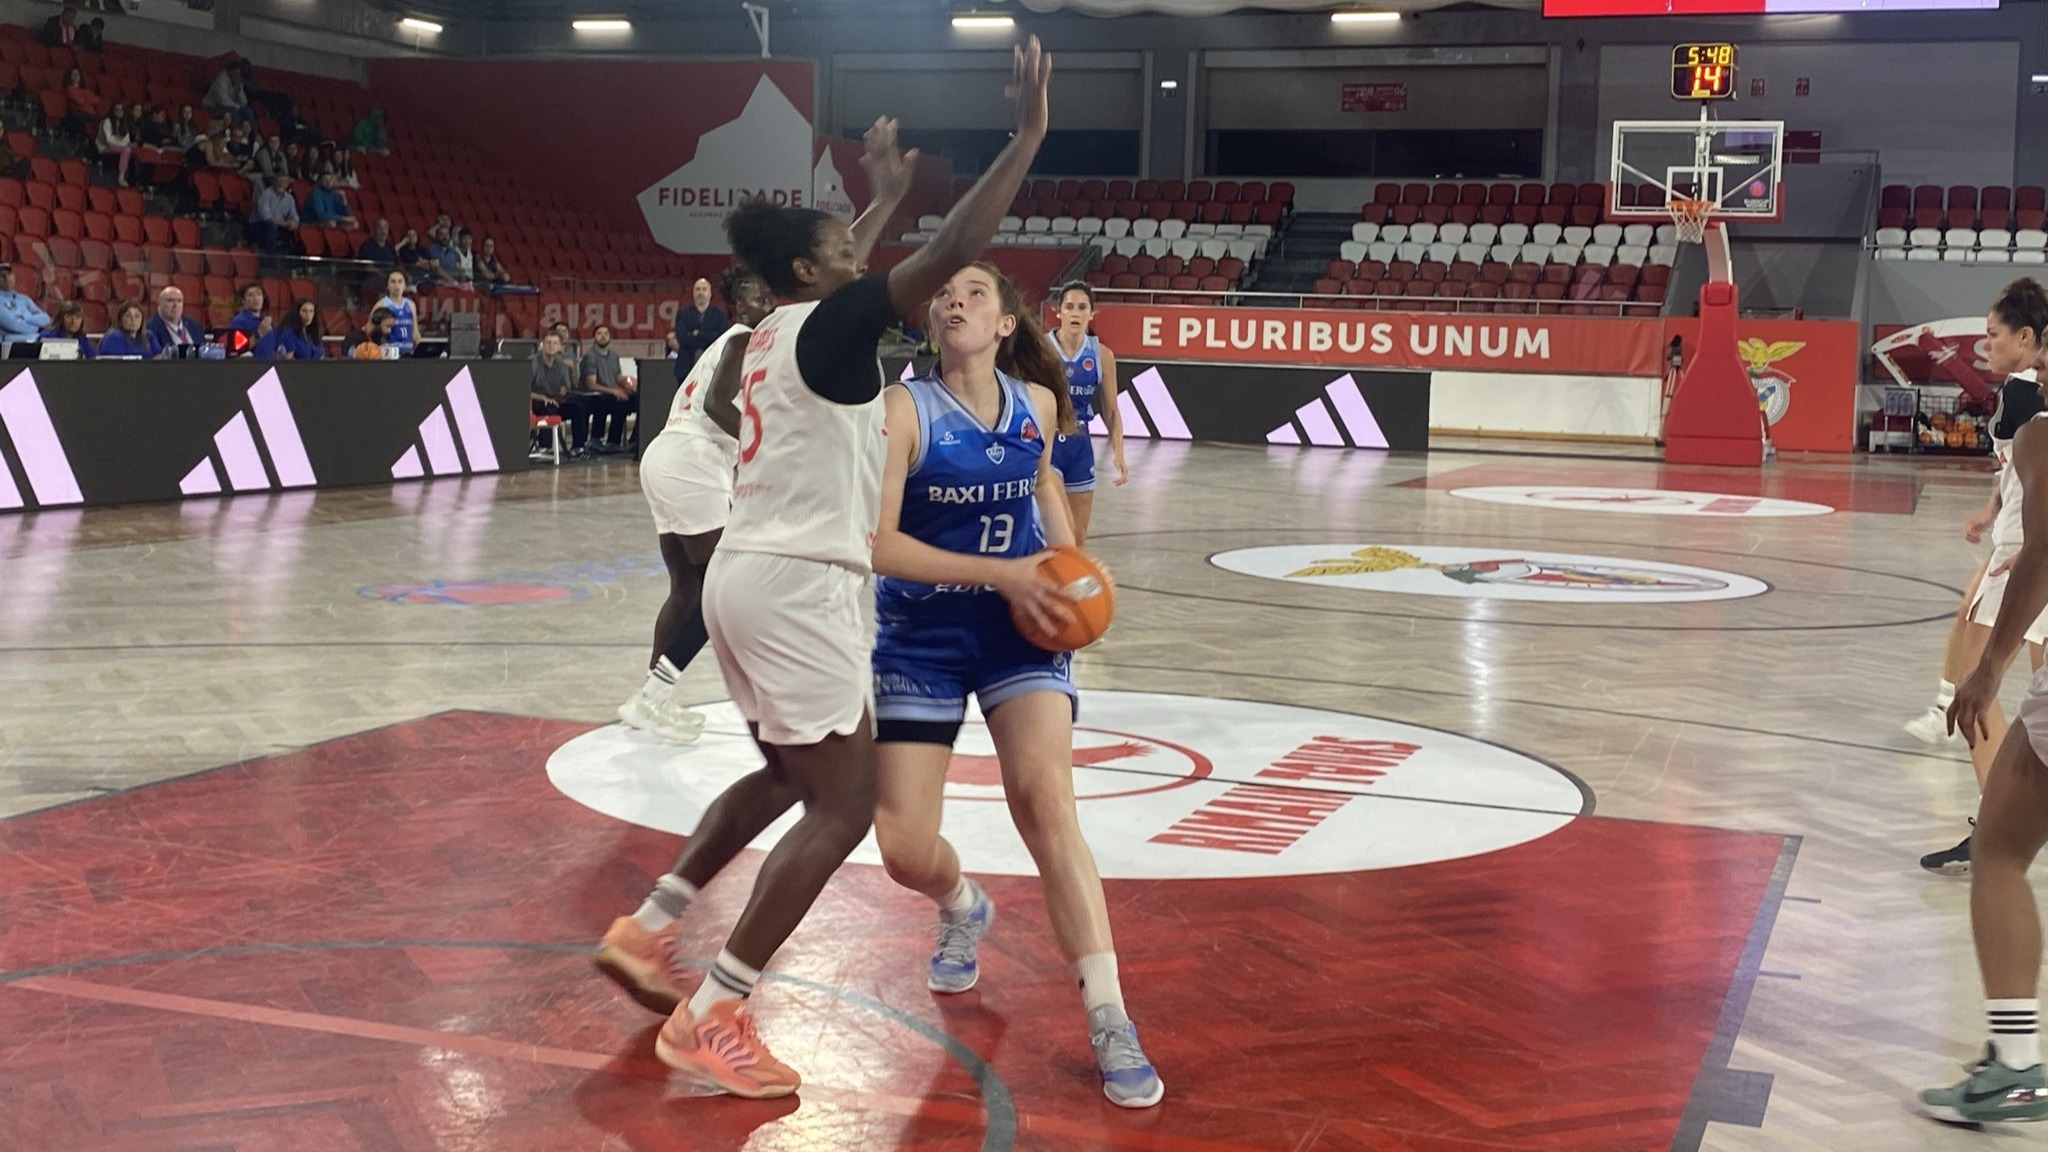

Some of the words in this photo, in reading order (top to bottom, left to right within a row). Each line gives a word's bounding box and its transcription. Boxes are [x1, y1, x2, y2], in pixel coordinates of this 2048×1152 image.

[1688, 46, 1731, 65] 5:48
[1693, 66, 1721, 91] 14
[1142, 317, 1163, 346] E
[1178, 317, 1393, 354] PLURIBUS
[1410, 324, 1550, 359] UNUM
[929, 485, 985, 504] BAXI
[979, 513, 1014, 553] 13
